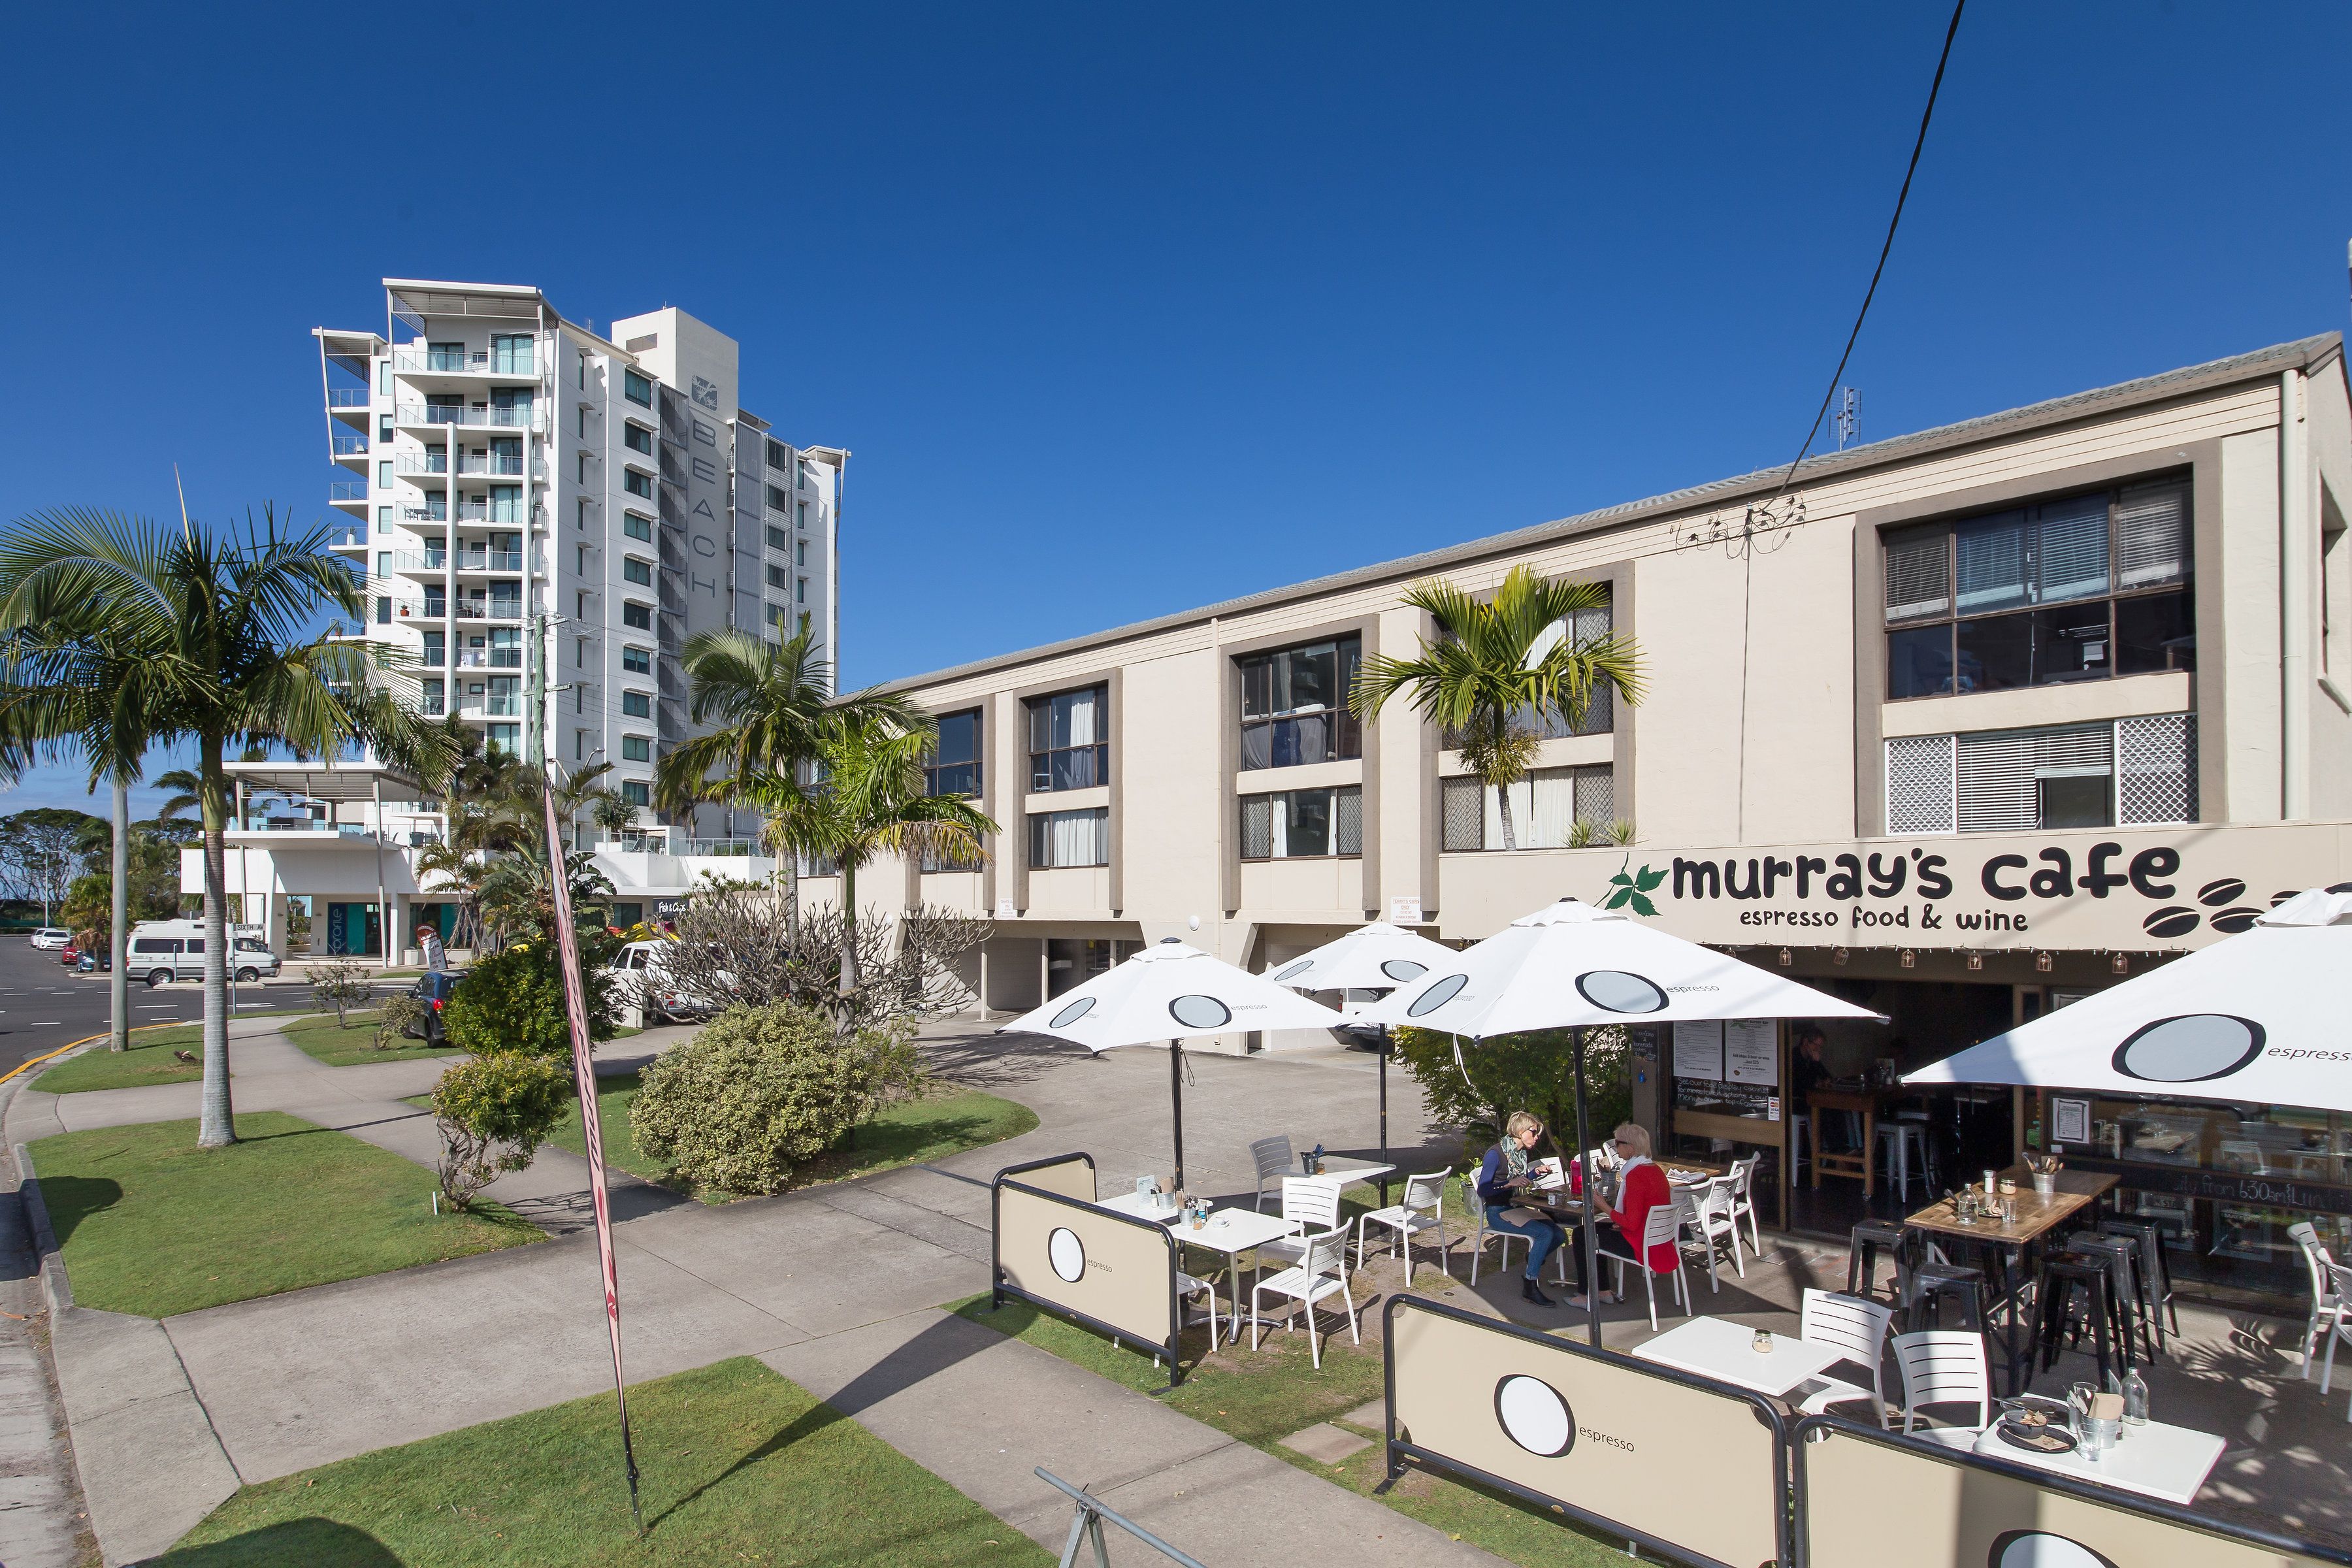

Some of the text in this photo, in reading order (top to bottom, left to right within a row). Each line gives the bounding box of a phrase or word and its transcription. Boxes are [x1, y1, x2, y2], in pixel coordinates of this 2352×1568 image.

[691, 419, 716, 598] BEACH
[1673, 842, 2181, 901] murray's cafe
[659, 901, 668, 913] Fish
[1740, 903, 2029, 931] espresso food & wine
[2268, 1047, 2352, 1061] espress
[1087, 1259, 1113, 1273] espresso
[1579, 1427, 1635, 1452] espresso
